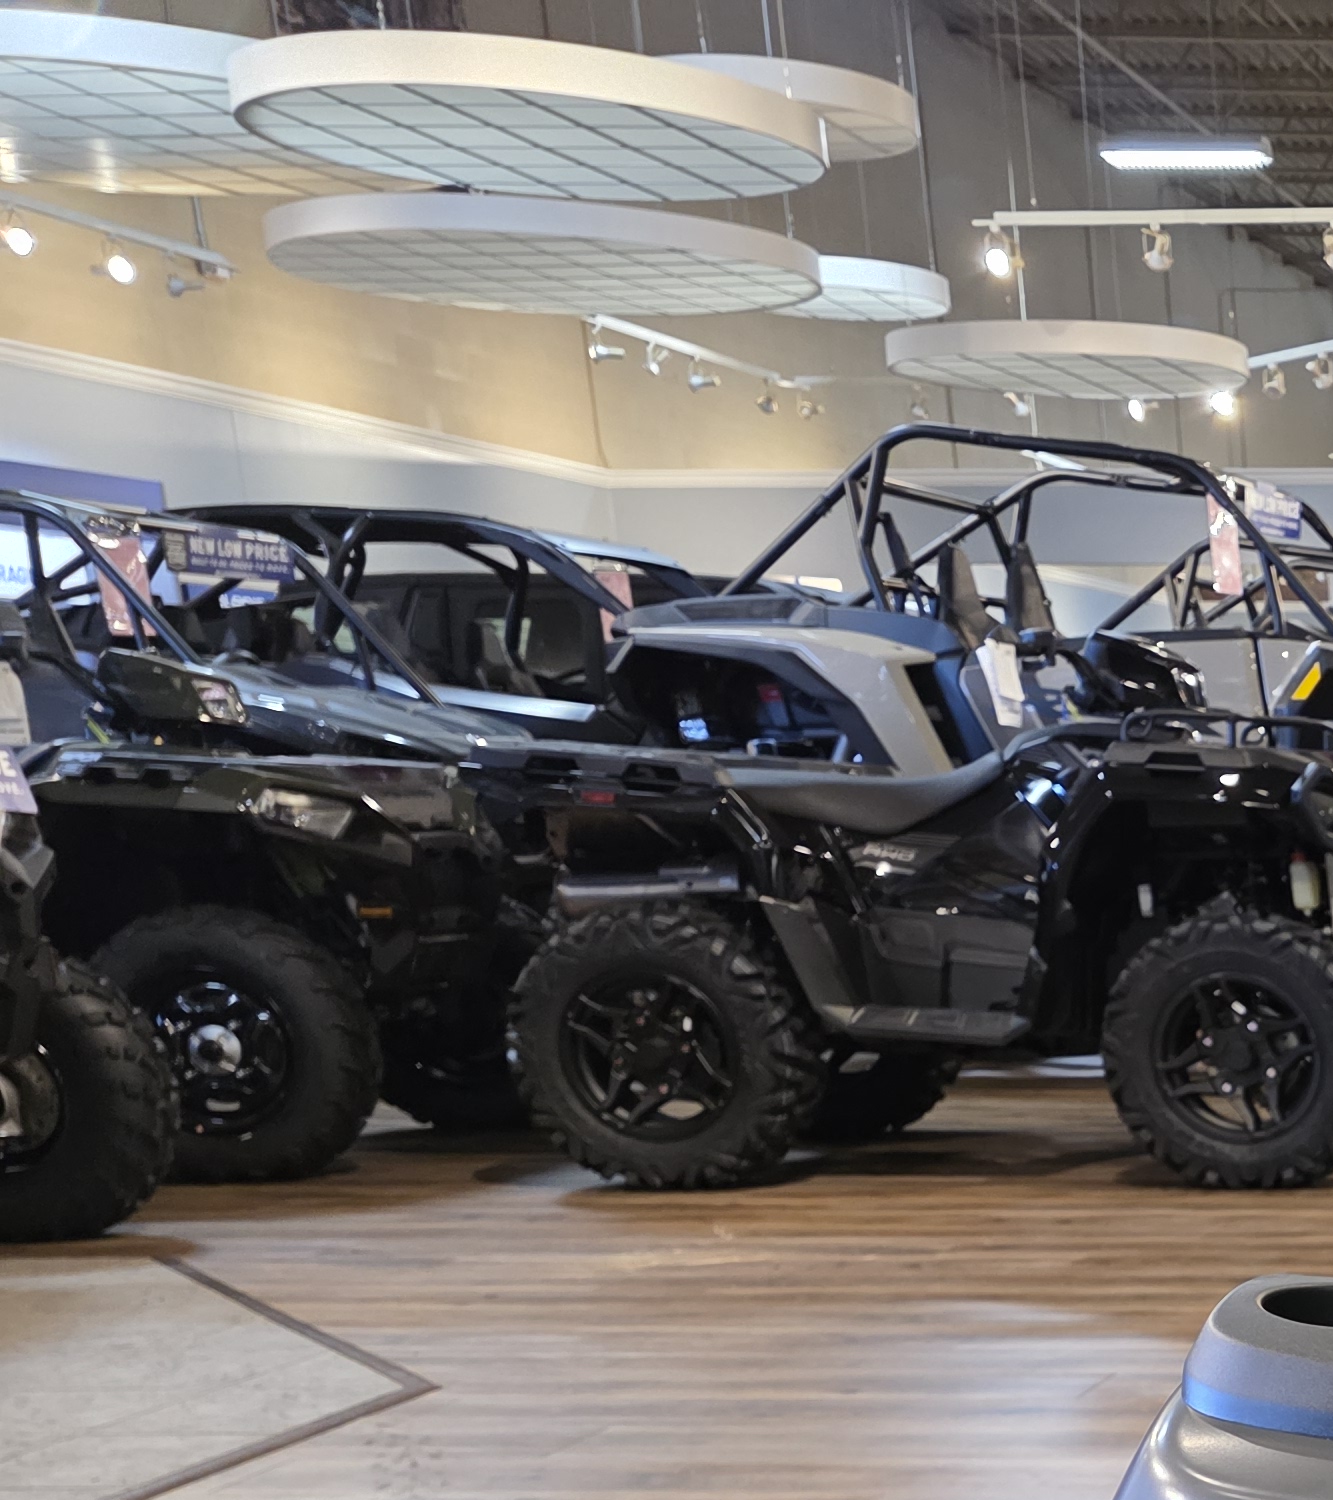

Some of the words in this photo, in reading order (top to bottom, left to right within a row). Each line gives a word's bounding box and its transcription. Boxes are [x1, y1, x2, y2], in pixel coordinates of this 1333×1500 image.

[189, 535, 215, 556] NEW
[217, 538, 243, 558] LOW
[245, 542, 290, 563] PRICE
